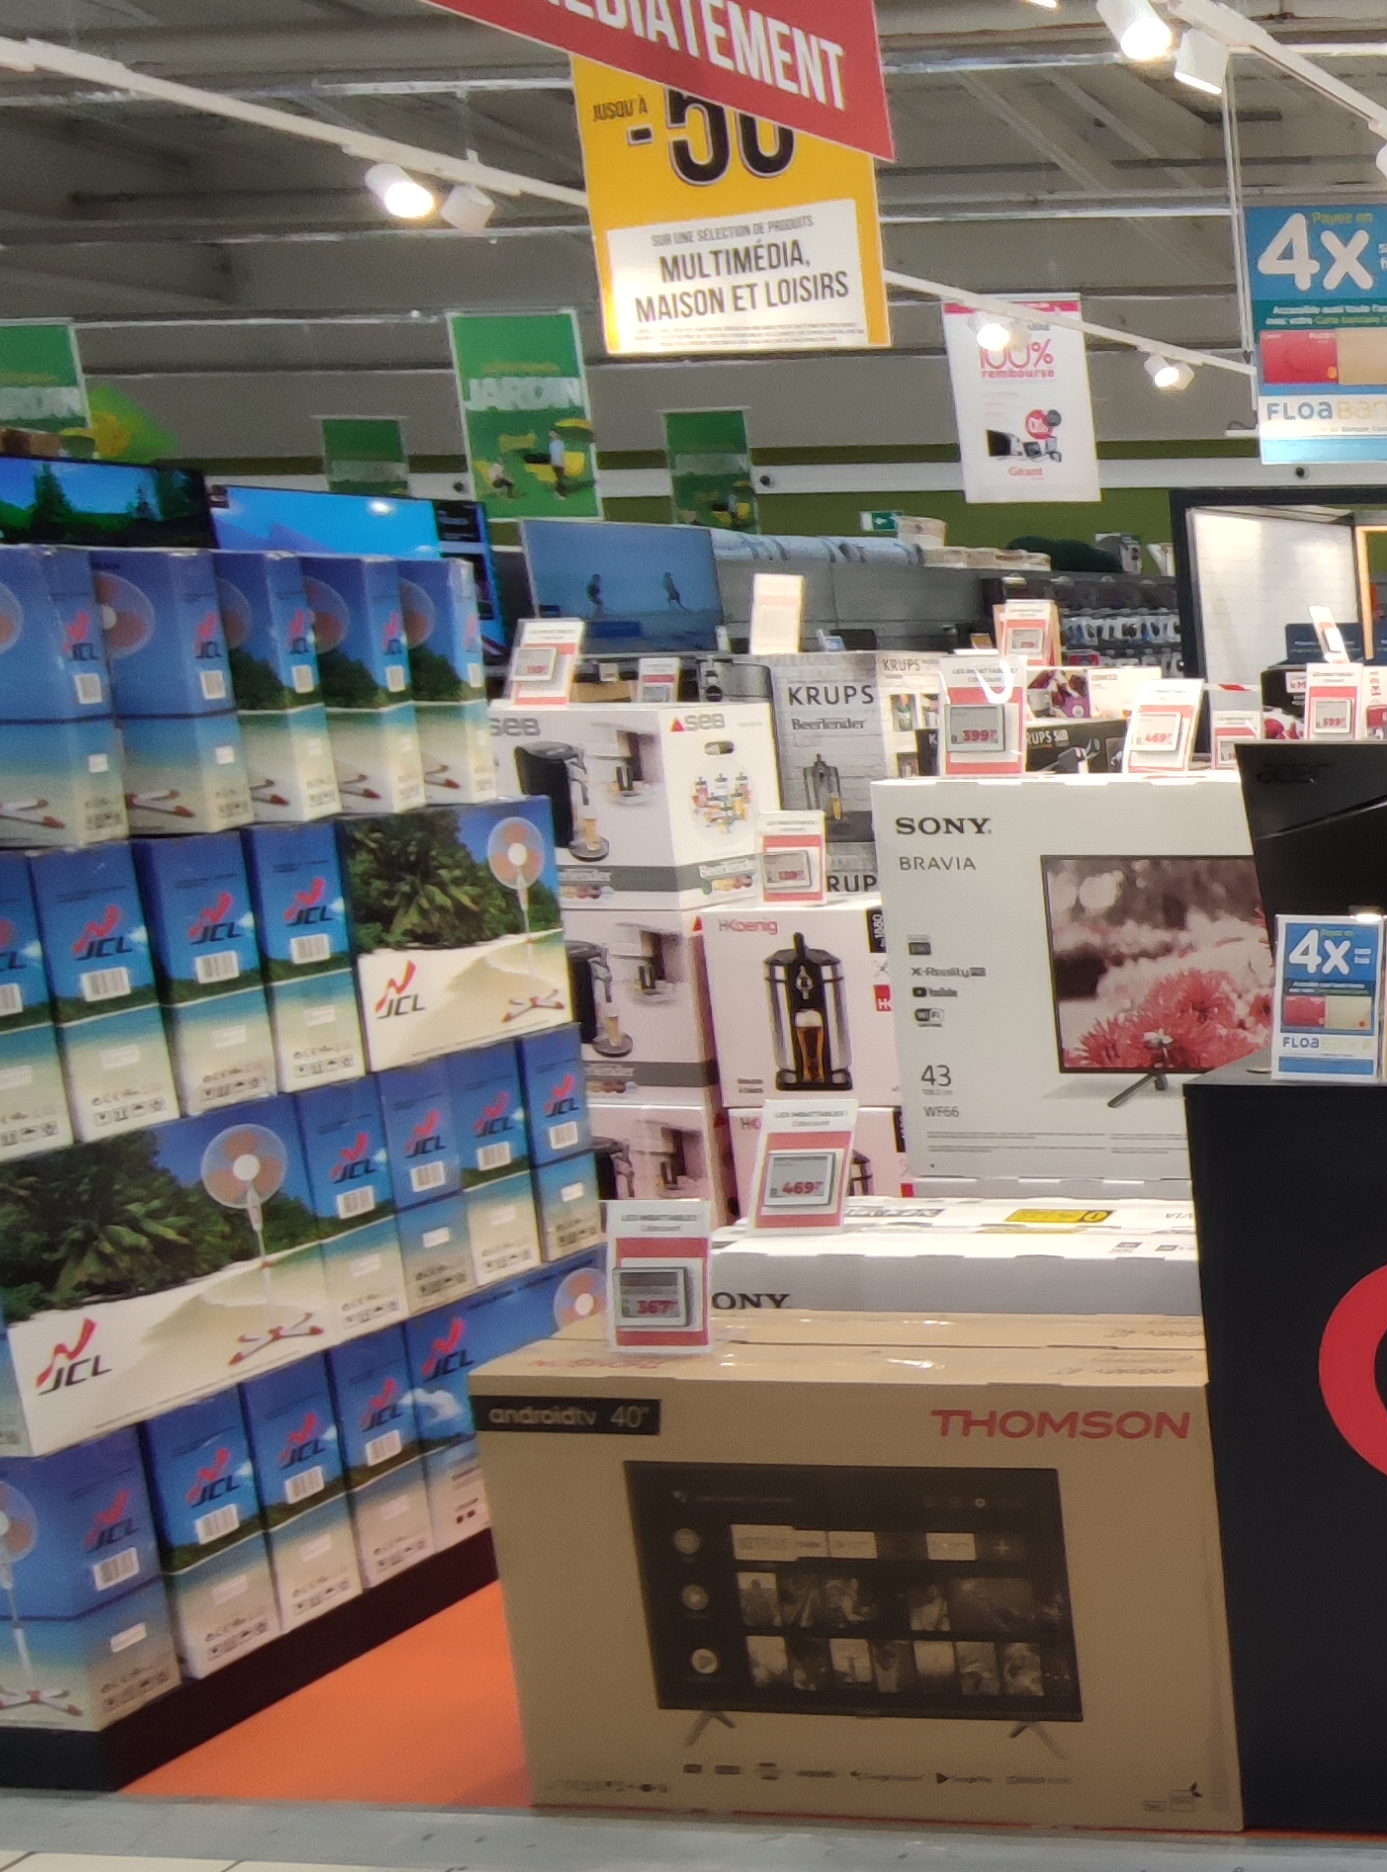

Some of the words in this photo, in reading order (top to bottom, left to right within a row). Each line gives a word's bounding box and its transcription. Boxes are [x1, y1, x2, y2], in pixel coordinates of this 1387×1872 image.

[651, 232, 671, 247] SUR
[673, 230, 694, 245] UNE
[697, 222, 751, 241] SÉLECTION
[753, 221, 766, 235] DE
[767, 215, 814, 233] PRODUITS
[659, 239, 811, 283] MULTIMÉDIA,
[635, 289, 725, 323] MAISON
[734, 284, 758, 311] ET
[765, 271, 850, 307] LOISIRS
[788, 685, 876, 706] KRUPS
[895, 816, 988, 835] SONY
[899, 857, 977, 872] BRAVIA
[286, 905, 333, 927] JCL
[190, 921, 242, 945] JCL
[74, 936, 133, 961] JCL
[377, 995, 427, 1019] JCL
[921, 1064, 952, 1086] 43
[545, 1096, 581, 1118] JCL
[477, 1113, 517, 1137] JCL
[405, 1135, 446, 1159] JCL
[333, 1159, 379, 1184] JCL
[711, 1292, 790, 1310] ONY
[37, 1355, 112, 1396] JCL
[424, 1349, 475, 1383] JCL
[361, 1404, 402, 1432] JCL
[488, 1406, 598, 1427] androidtv
[930, 1408, 1192, 1441] THOMSON
[280, 1441, 326, 1469] JCL
[191, 1474, 241, 1508] JCL
[86, 1516, 140, 1554] JCL
